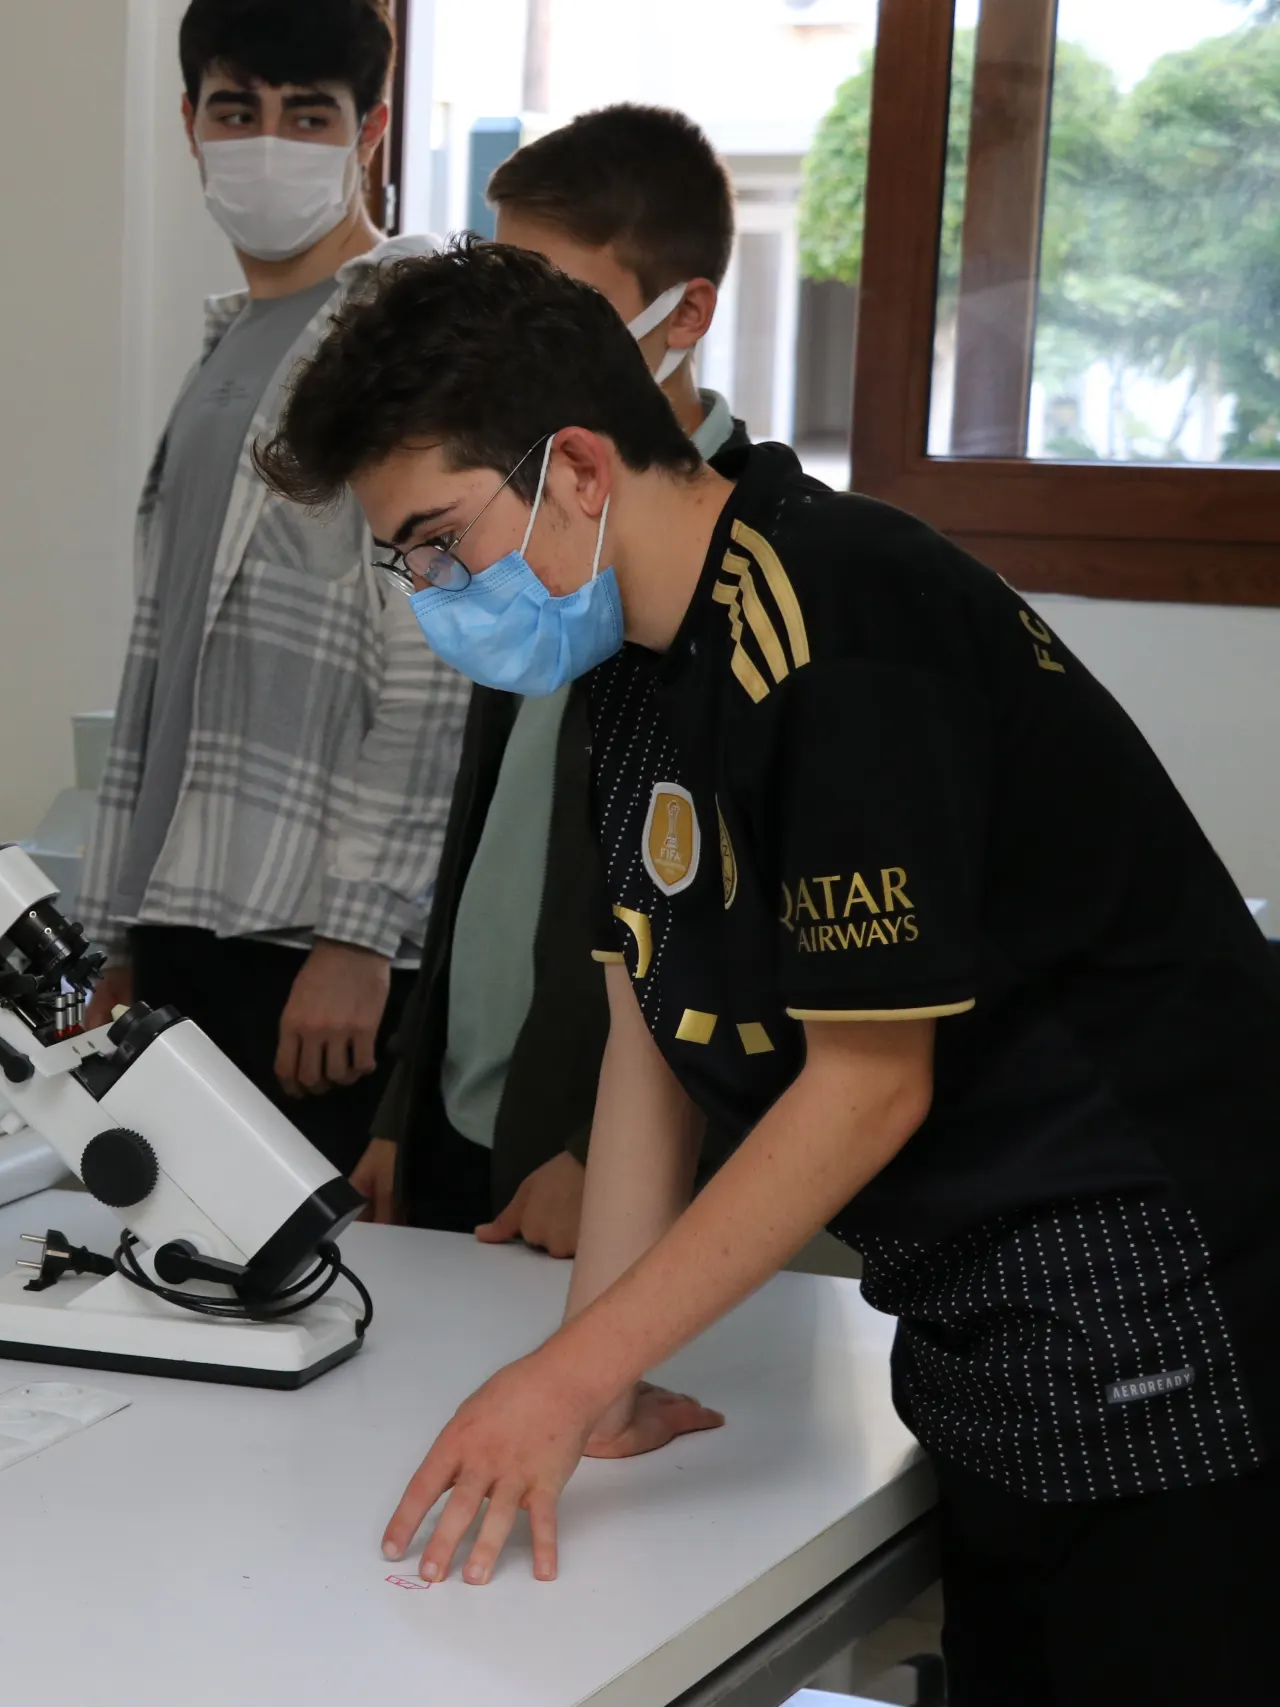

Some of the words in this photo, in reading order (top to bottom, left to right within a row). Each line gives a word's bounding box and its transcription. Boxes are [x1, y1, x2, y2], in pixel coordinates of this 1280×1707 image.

[1019, 610, 1065, 673] FC
[660, 848, 681, 861] FIFA
[799, 914, 919, 952] AIRWAYS
[1113, 1374, 1190, 1399] AEROREADY
